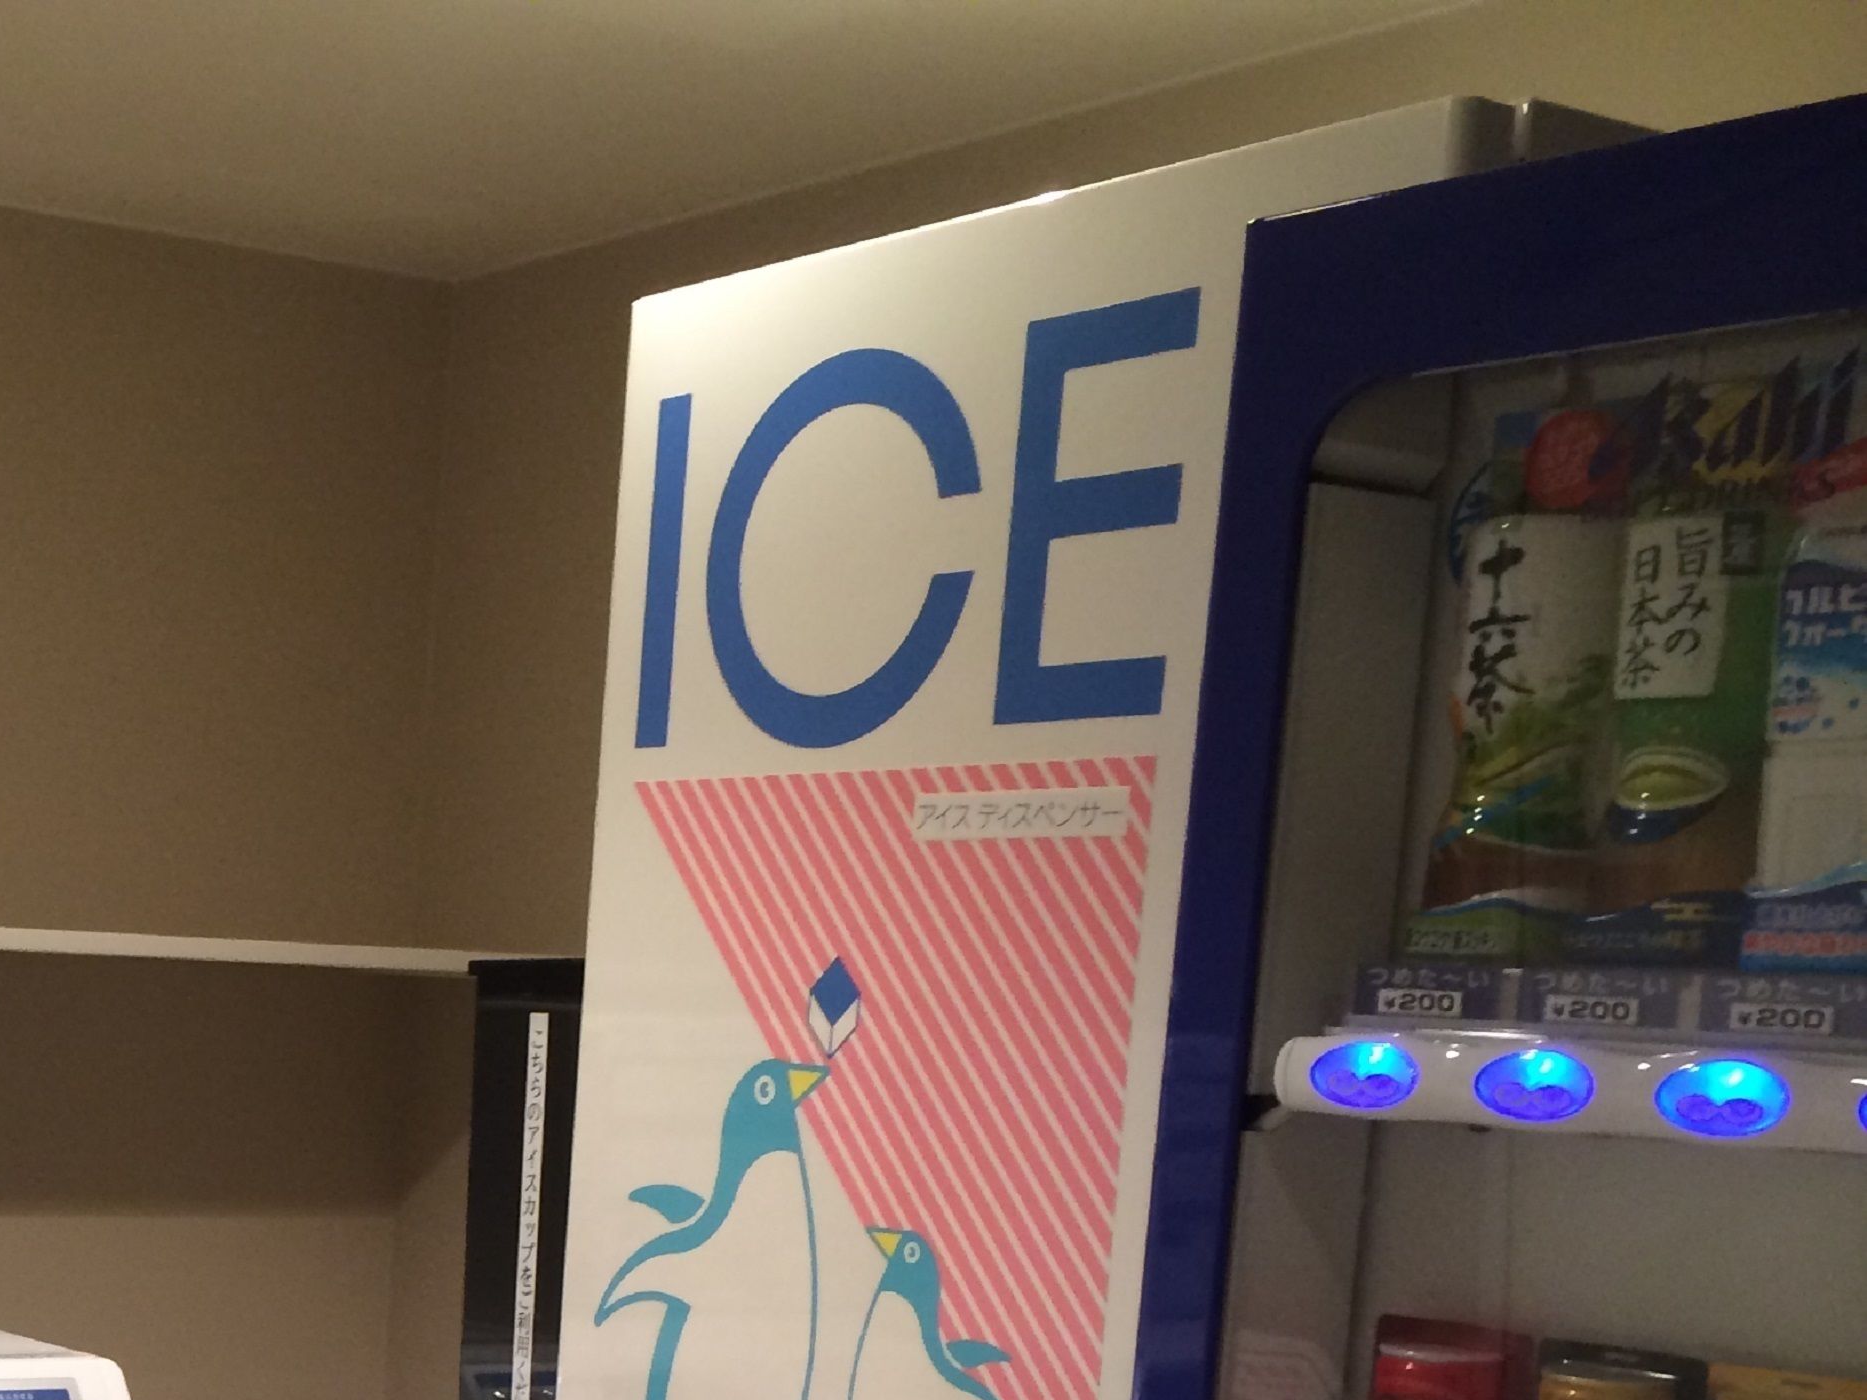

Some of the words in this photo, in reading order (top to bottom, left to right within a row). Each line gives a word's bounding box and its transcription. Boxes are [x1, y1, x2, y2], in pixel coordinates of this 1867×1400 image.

[635, 286, 1202, 749] ICE
[1469, 540, 1536, 734] 十六茶
[1620, 547, 1665, 688] 日本茶
[1664, 525, 1711, 656] 旨みの
[1383, 992, 1456, 1013] ¥200
[1552, 999, 1631, 1020] ¥200
[1738, 1007, 1826, 1029] ¥200
